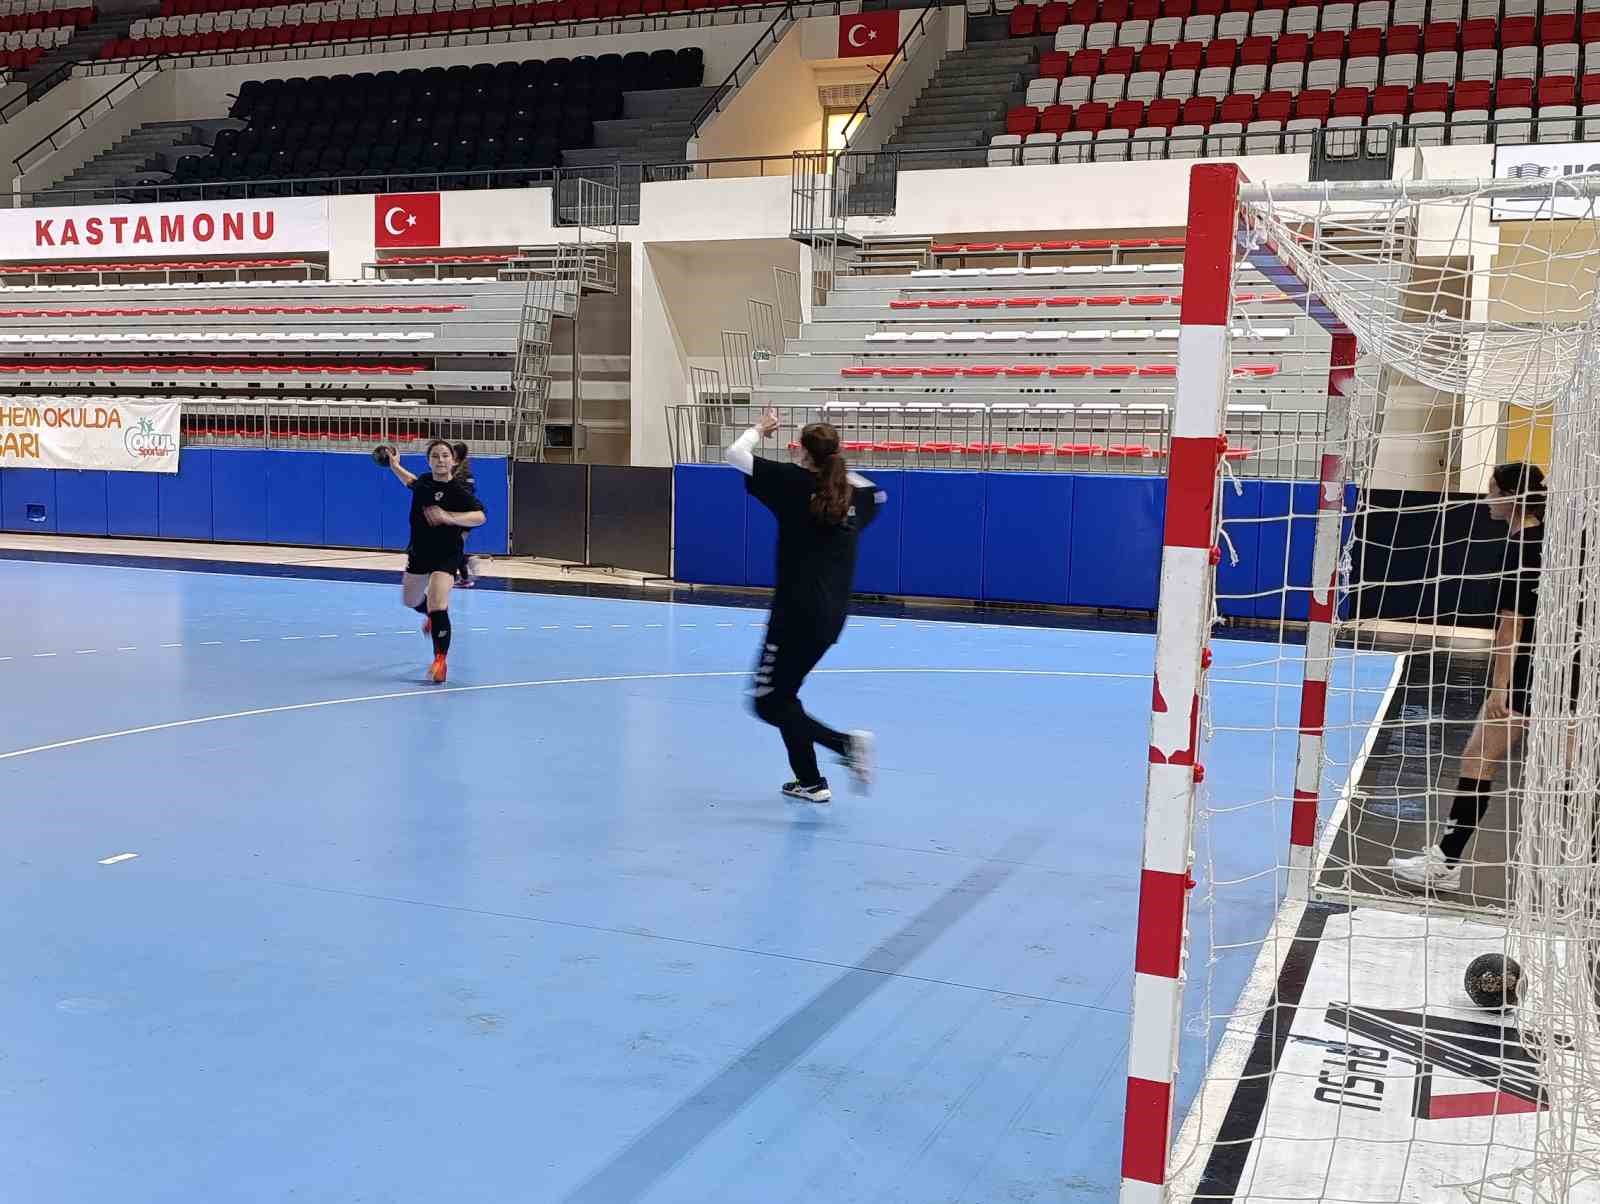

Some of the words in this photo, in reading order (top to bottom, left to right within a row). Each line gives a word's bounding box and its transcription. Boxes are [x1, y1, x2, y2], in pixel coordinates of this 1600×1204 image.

[34, 211, 275, 247] KASTAMONU
[0, 406, 41, 428] HEM
[43, 406, 122, 429] OKULDA
[0, 432, 40, 458] ARI
